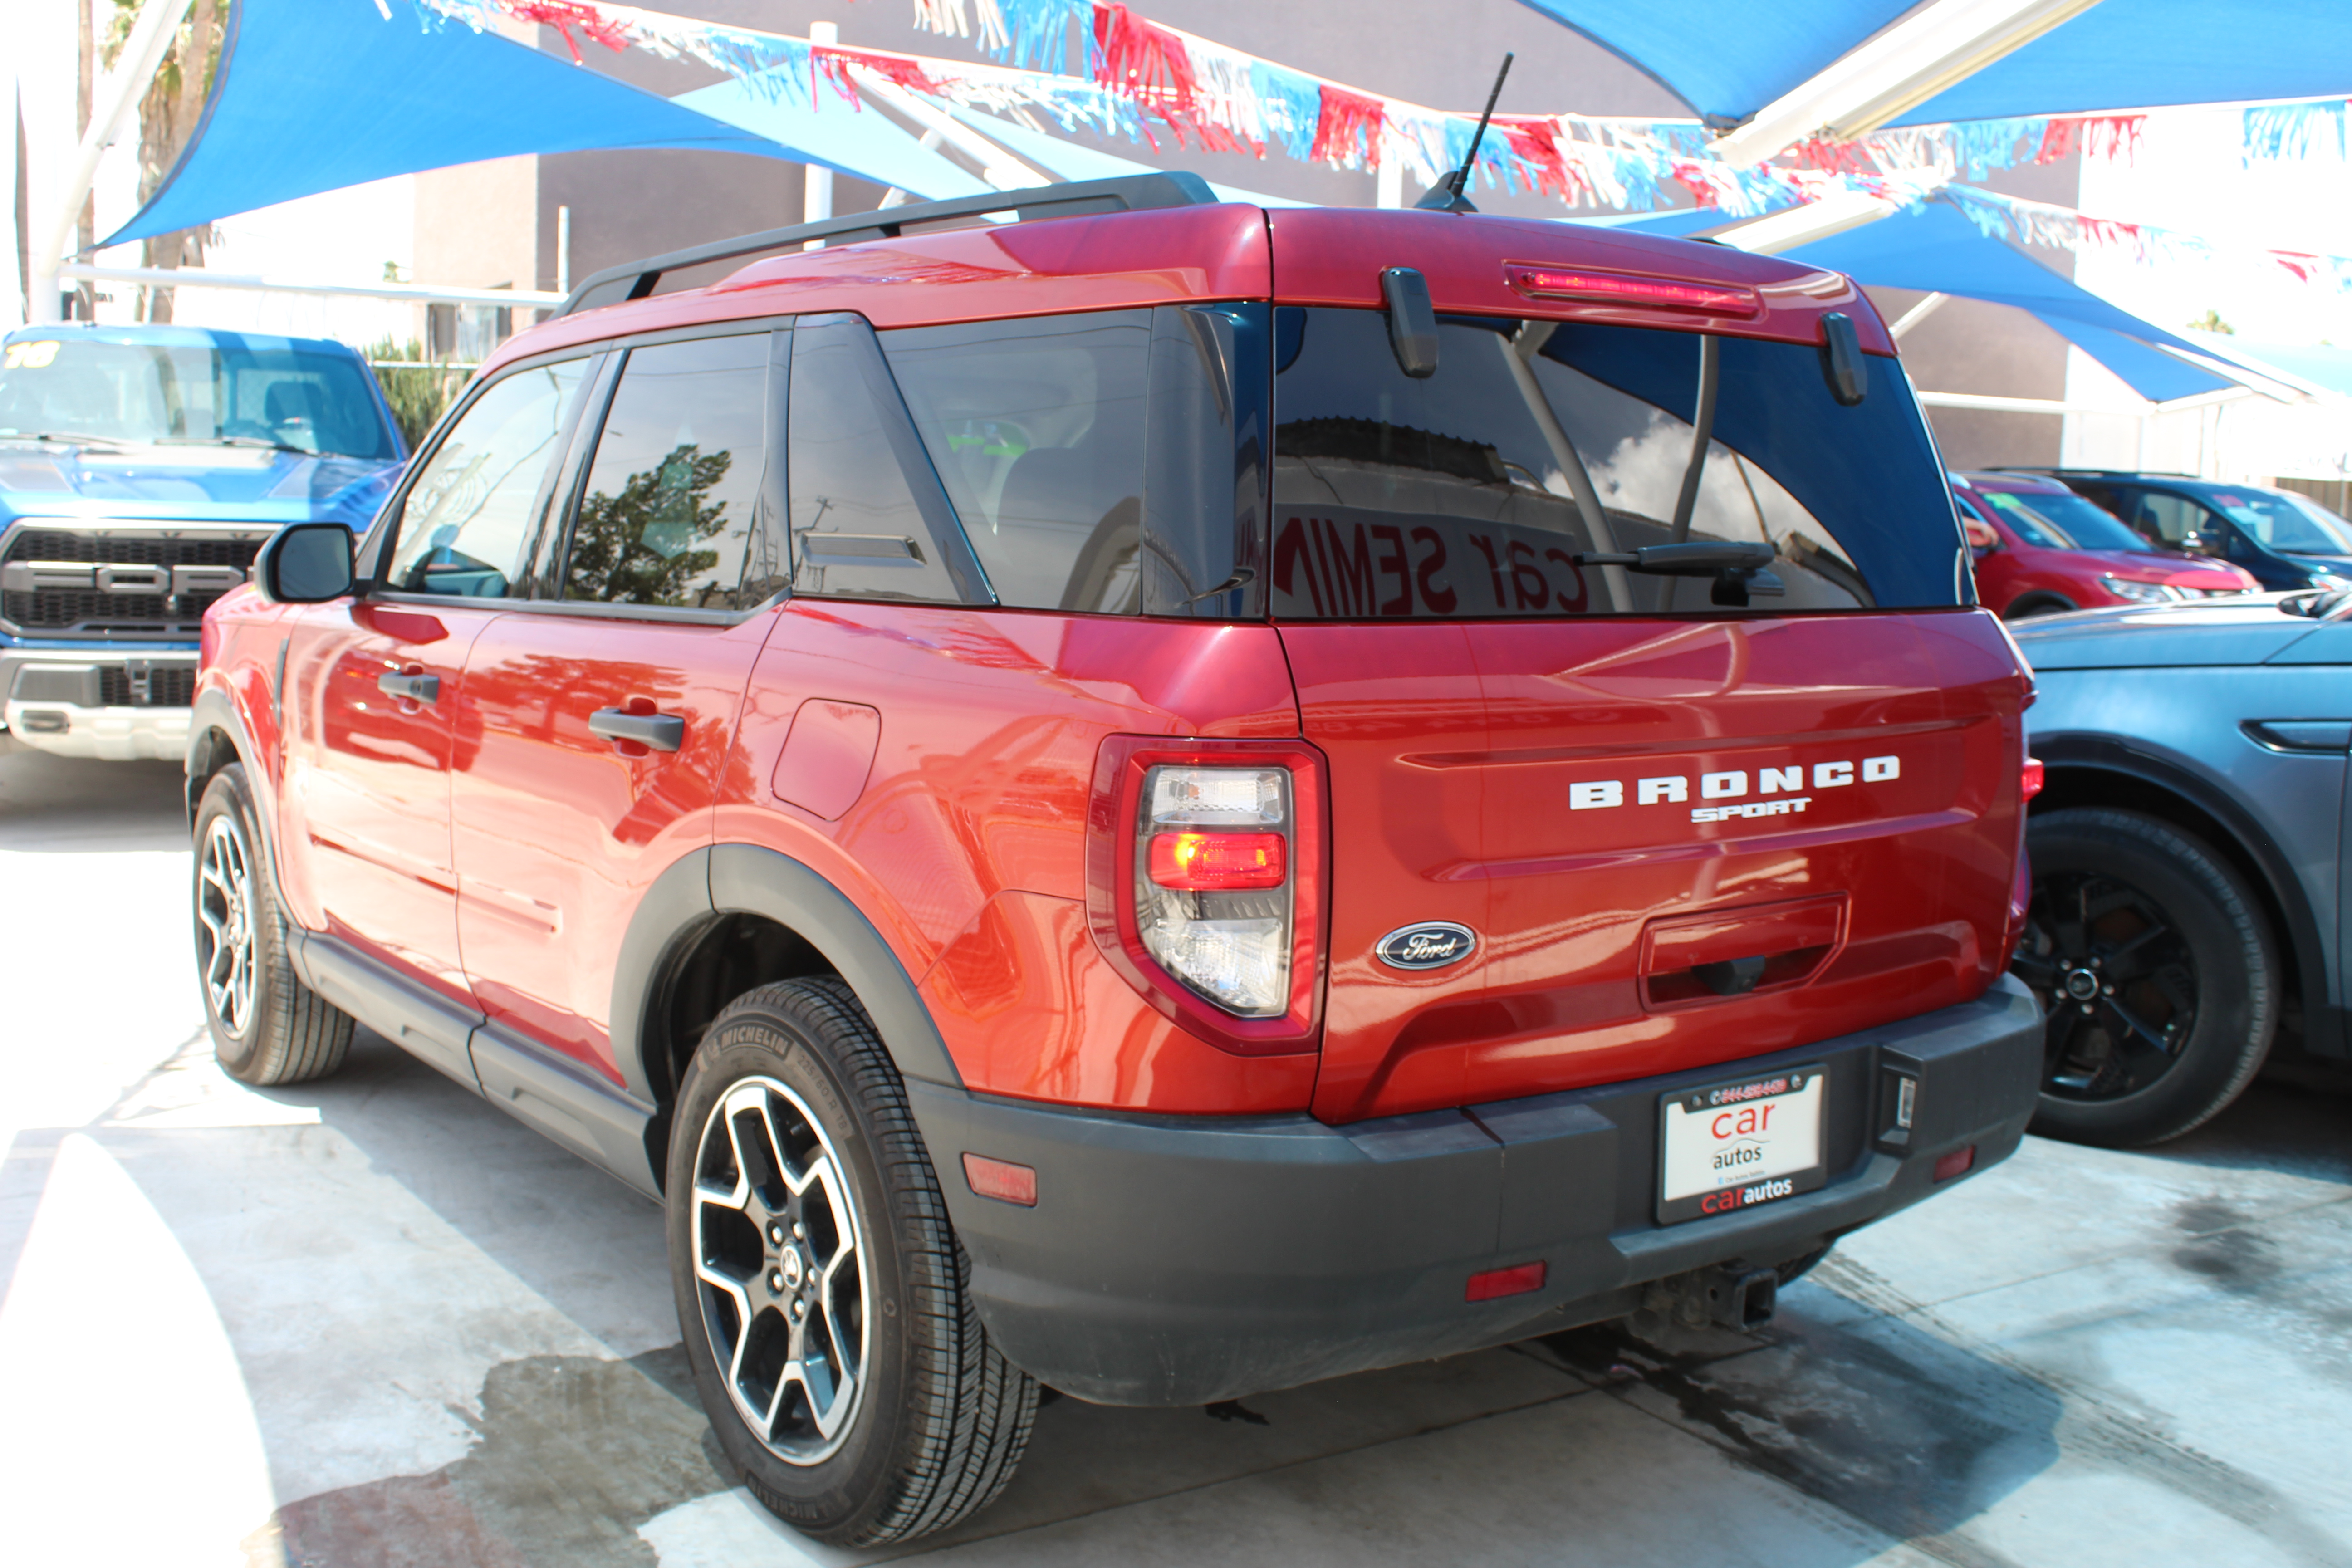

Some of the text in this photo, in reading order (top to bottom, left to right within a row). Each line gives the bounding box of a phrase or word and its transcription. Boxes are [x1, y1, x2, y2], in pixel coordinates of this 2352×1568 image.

[1570, 755, 1900, 810] BRONCO
[1691, 797, 1812, 823] SPORT
[1402, 933, 1457, 960] Ford
[721, 1026, 789, 1055] MICHELIN
[798, 1055, 829, 1097] 225/60
[1711, 1104, 1775, 1139] car
[1713, 1146, 1761, 1170] autos
